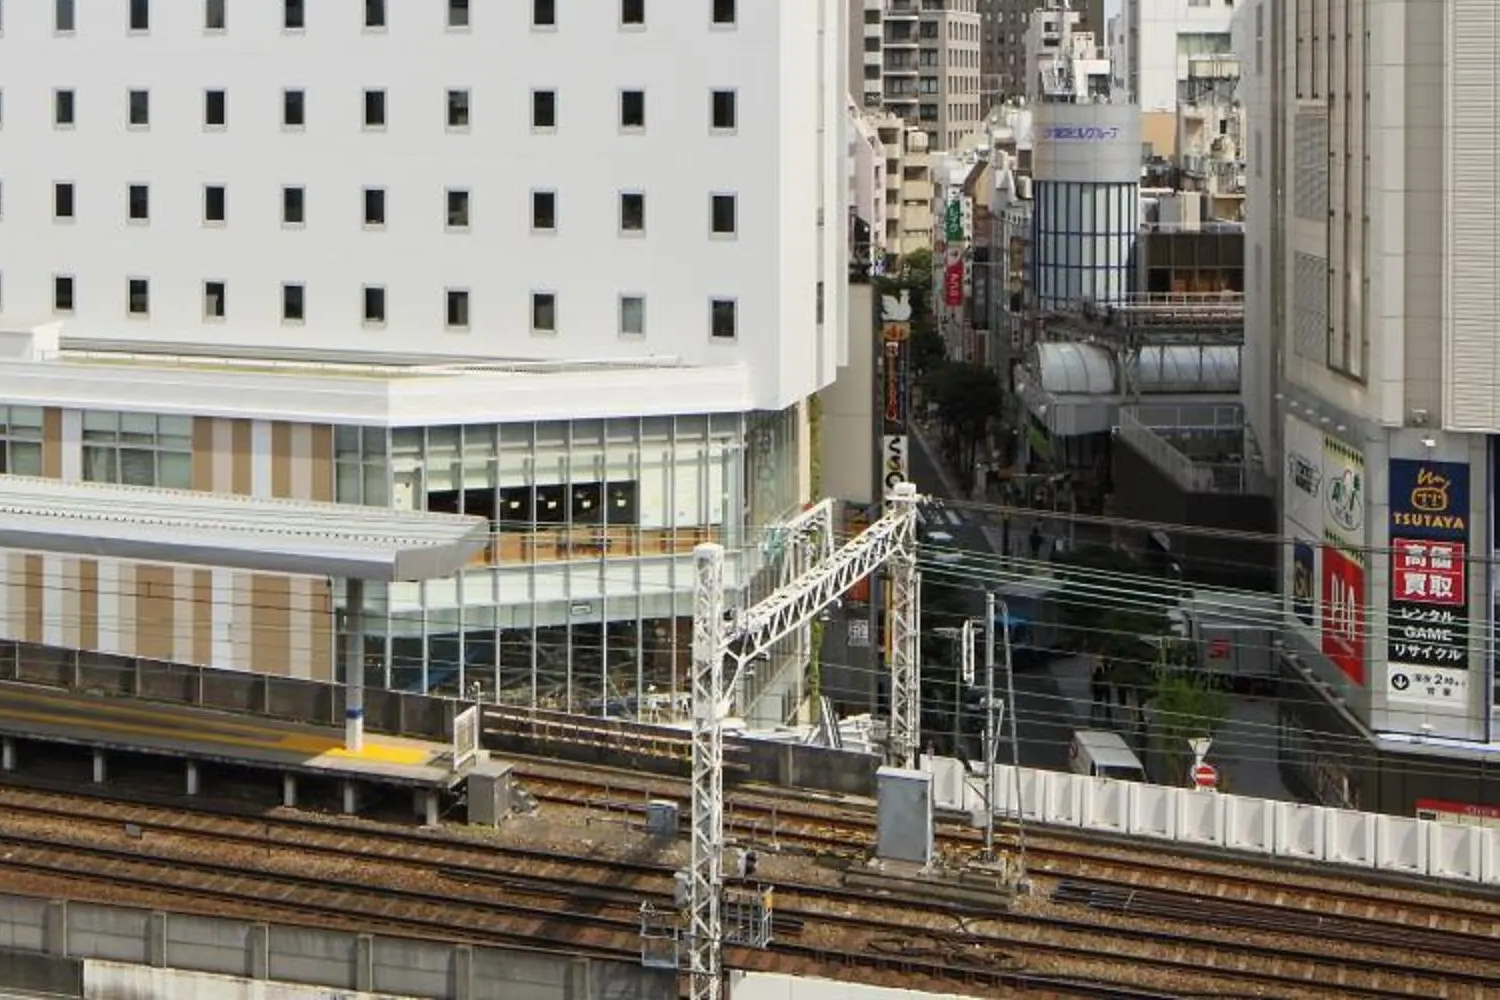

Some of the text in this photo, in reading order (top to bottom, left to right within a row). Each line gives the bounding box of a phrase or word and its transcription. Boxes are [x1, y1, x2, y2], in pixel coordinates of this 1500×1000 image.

[1394, 512, 1464, 529] TSUTAYA
[1404, 571, 1453, 597] 買取
[1401, 607, 1457, 622] レンタル
[1405, 626, 1452, 641] GAME
[1395, 643, 1465, 660] リサイクル
